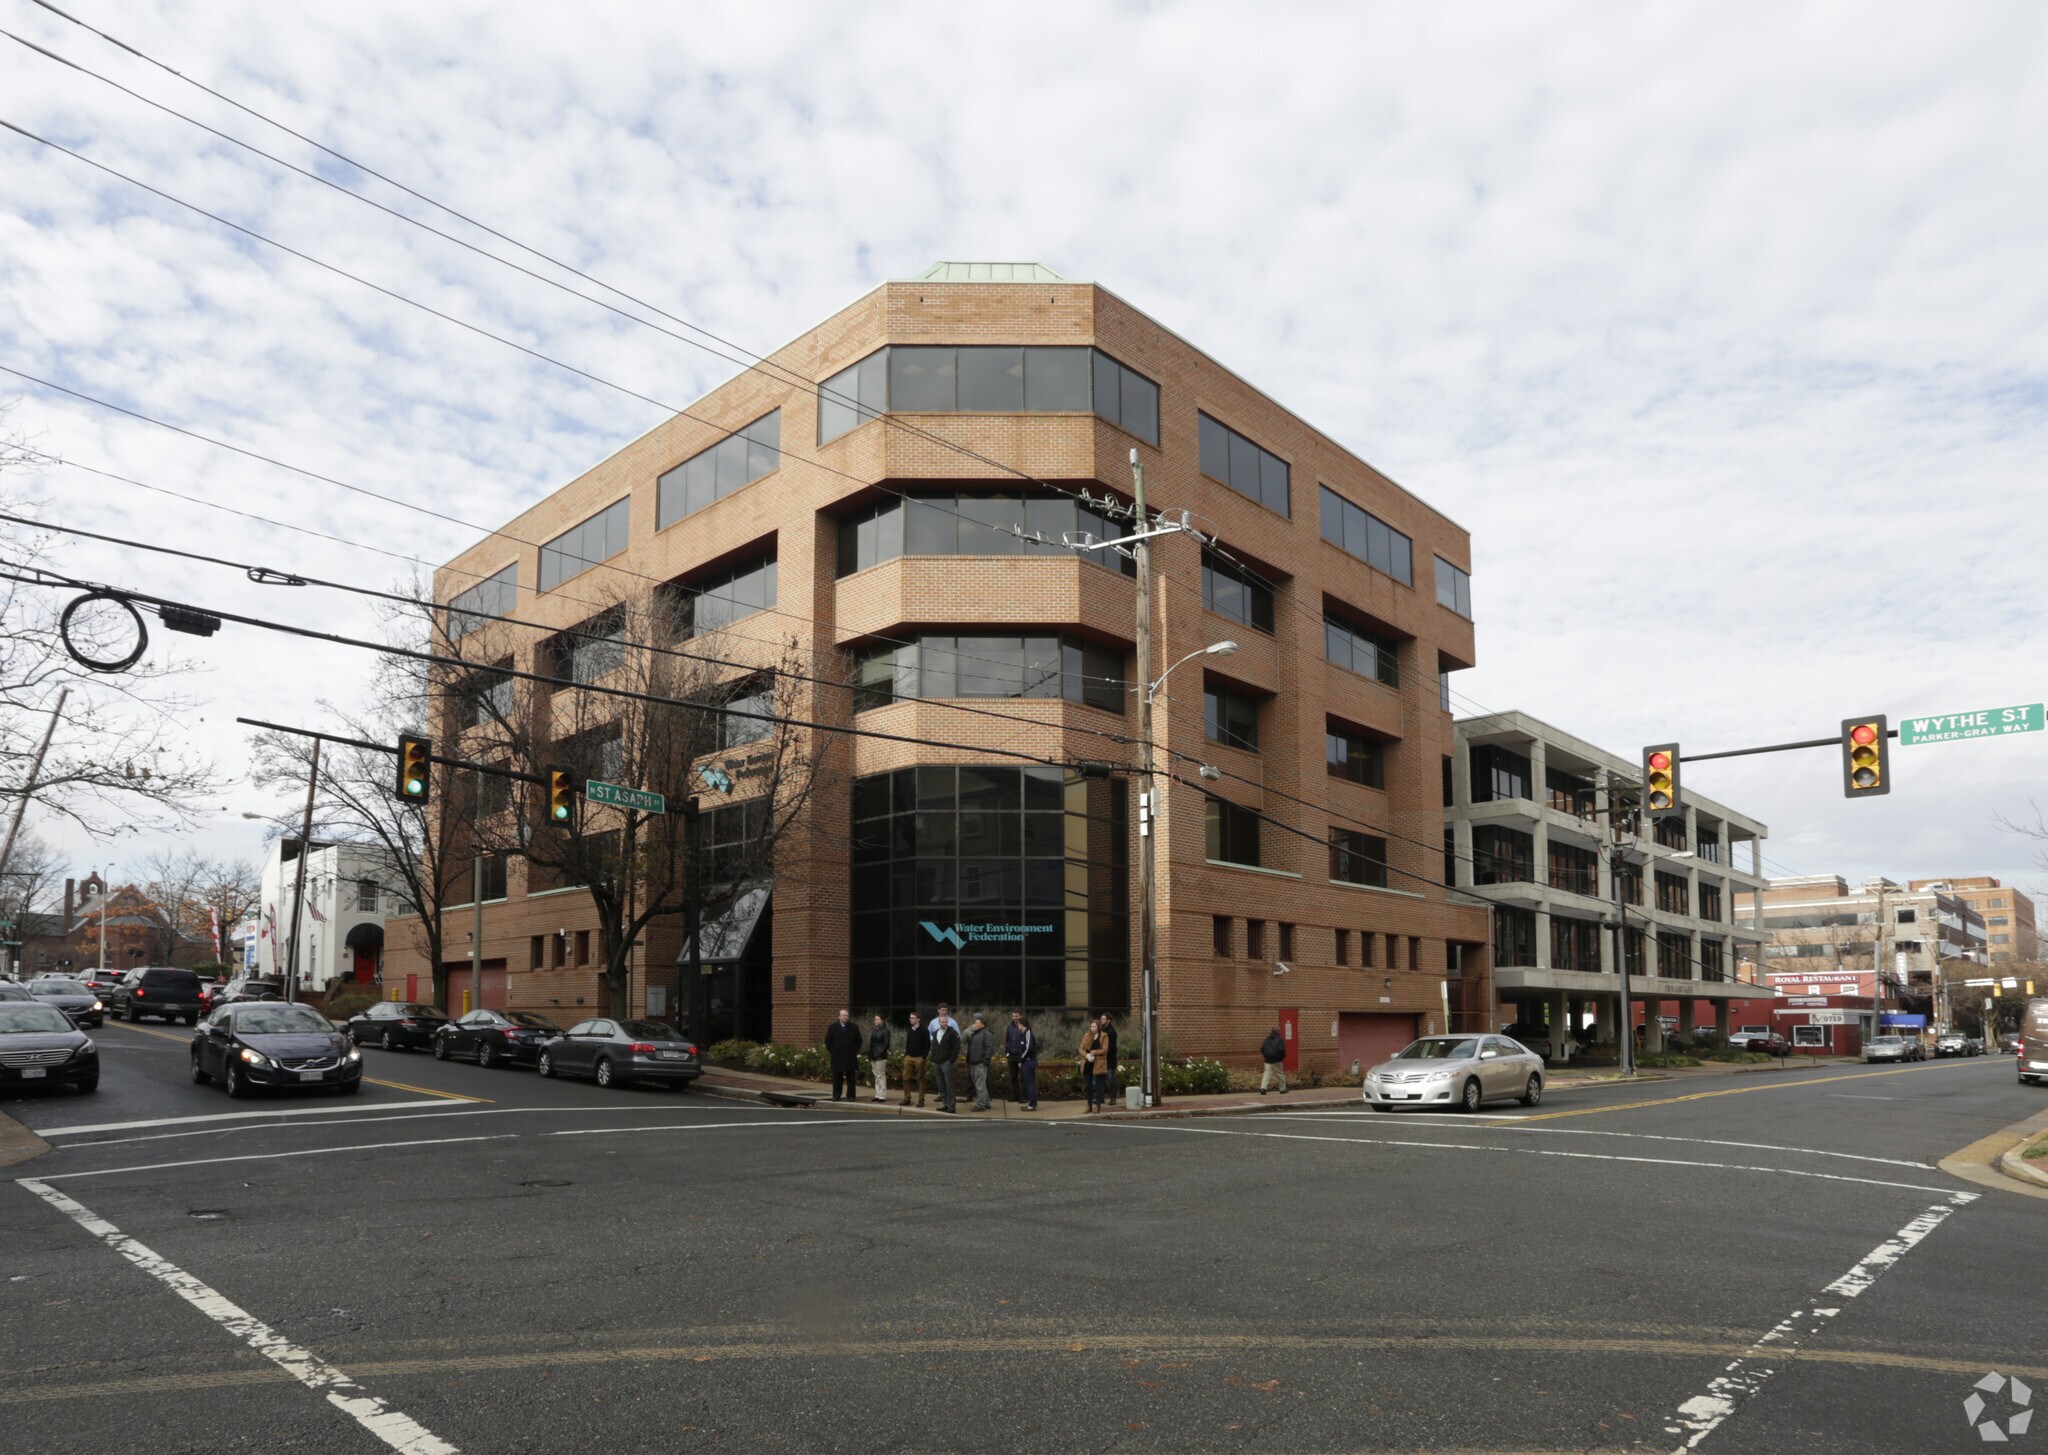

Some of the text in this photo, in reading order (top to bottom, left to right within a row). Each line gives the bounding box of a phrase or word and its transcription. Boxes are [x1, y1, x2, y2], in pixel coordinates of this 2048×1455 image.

[1912, 707, 2030, 733] WYTHE ST
[1912, 723, 2030, 743] PARKER-GRAY WAY
[590, 786, 595, 794] N
[596, 785, 611, 799] ST
[614, 789, 652, 807] ASAPH
[954, 923, 1054, 932] Water Environment
[968, 932, 1024, 941] Federation
